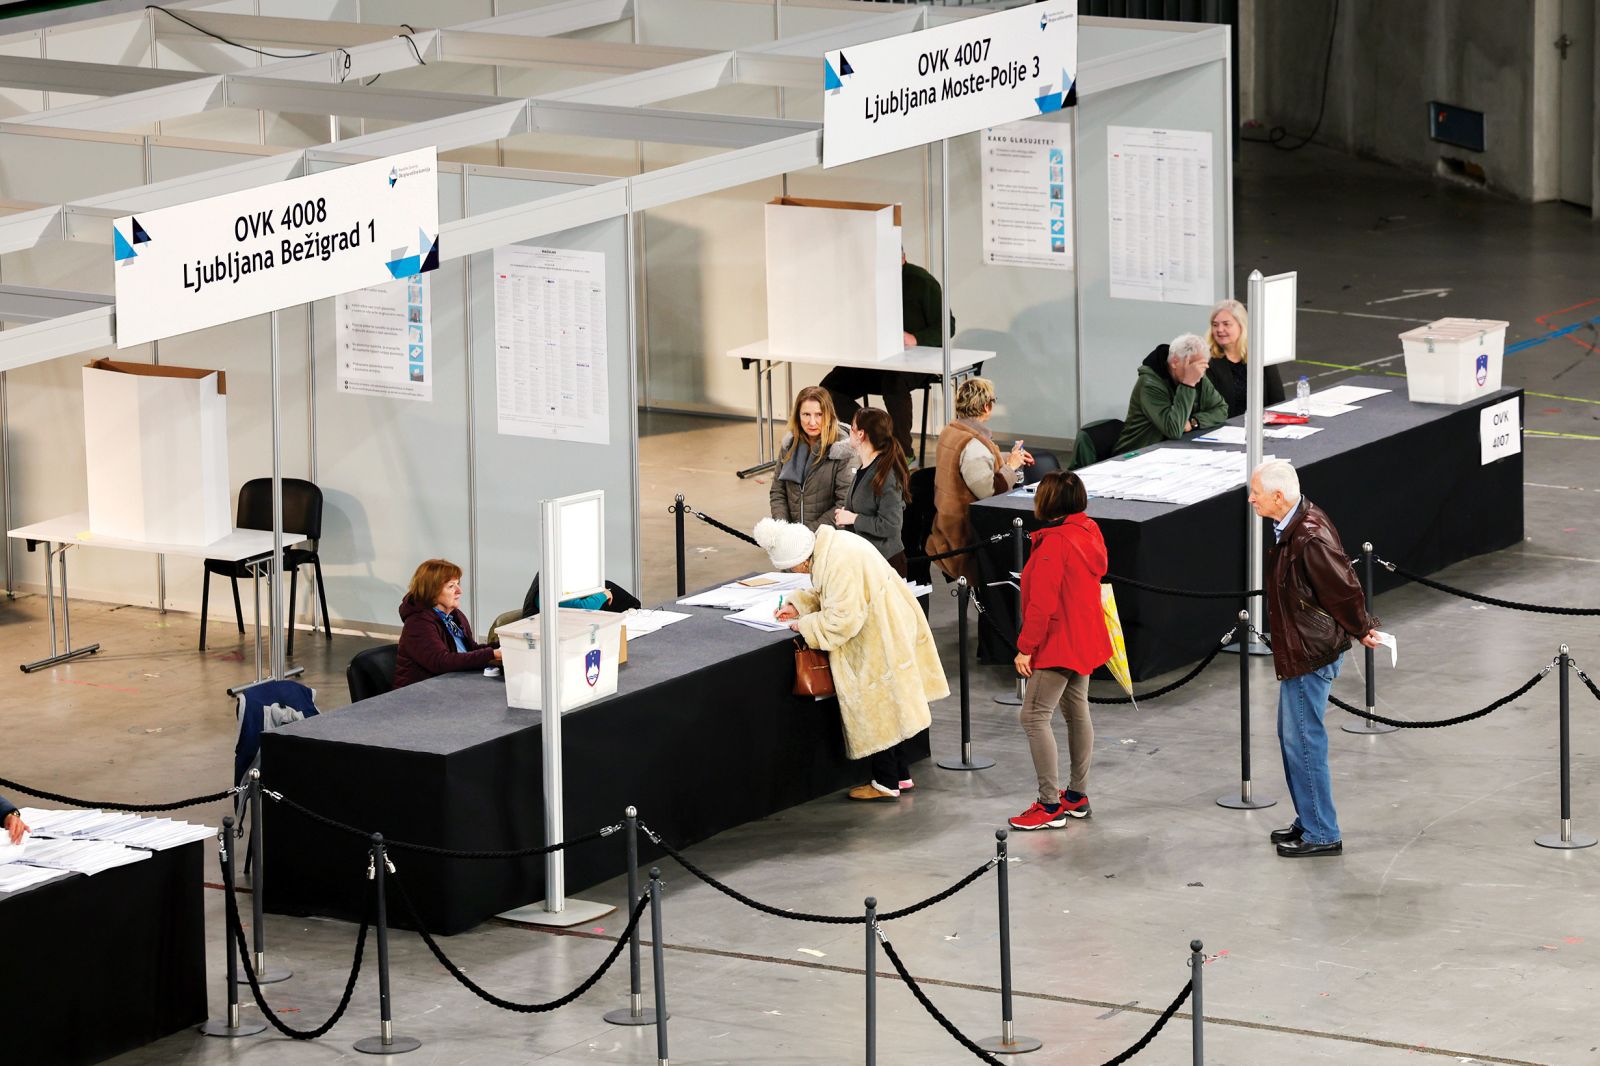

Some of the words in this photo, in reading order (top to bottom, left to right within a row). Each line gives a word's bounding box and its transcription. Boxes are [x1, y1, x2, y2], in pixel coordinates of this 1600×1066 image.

[918, 48, 949, 76] OVK
[954, 38, 991, 67] 4007
[865, 86, 936, 123] Ljubljana
[942, 62, 1027, 100] Moste-Polje
[1033, 56, 1040, 79] 3
[1010, 137, 1054, 145] GLASUJETE?
[235, 210, 276, 242] OVK
[281, 197, 327, 230] 4008
[183, 249, 275, 293] Ljubljana
[282, 222, 359, 265] Bežigrad
[367, 219, 375, 243] 1
[1493, 411, 1508, 426] OVK
[1493, 433, 1510, 447] 4007
